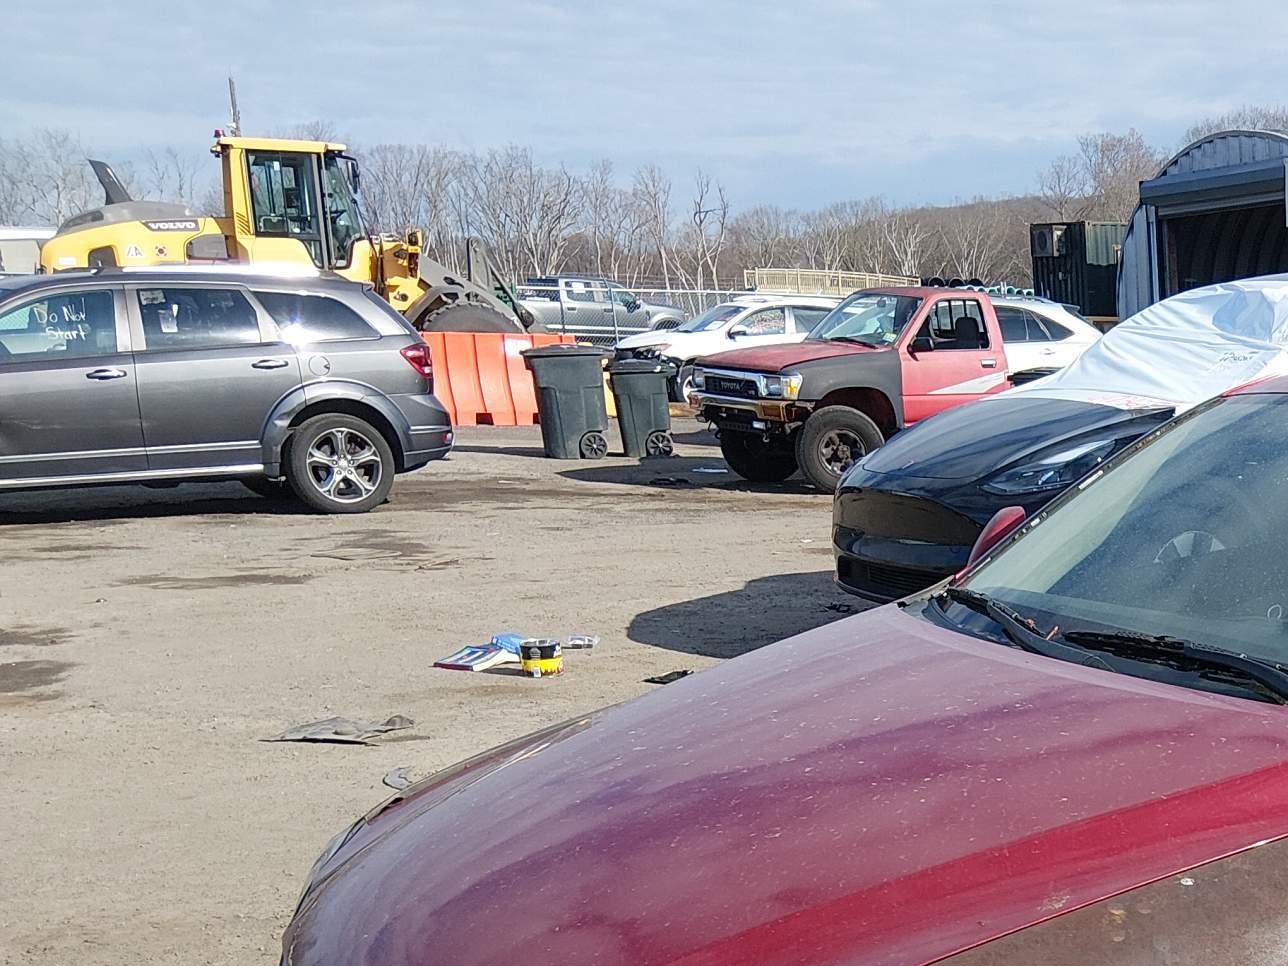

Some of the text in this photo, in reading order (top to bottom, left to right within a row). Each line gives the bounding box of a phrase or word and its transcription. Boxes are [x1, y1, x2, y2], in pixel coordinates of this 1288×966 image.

[148, 221, 197, 230] VOLVO
[33, 306, 58, 323] Do
[46, 324, 87, 341] Start
[720, 381, 741, 391] TOYOTA
